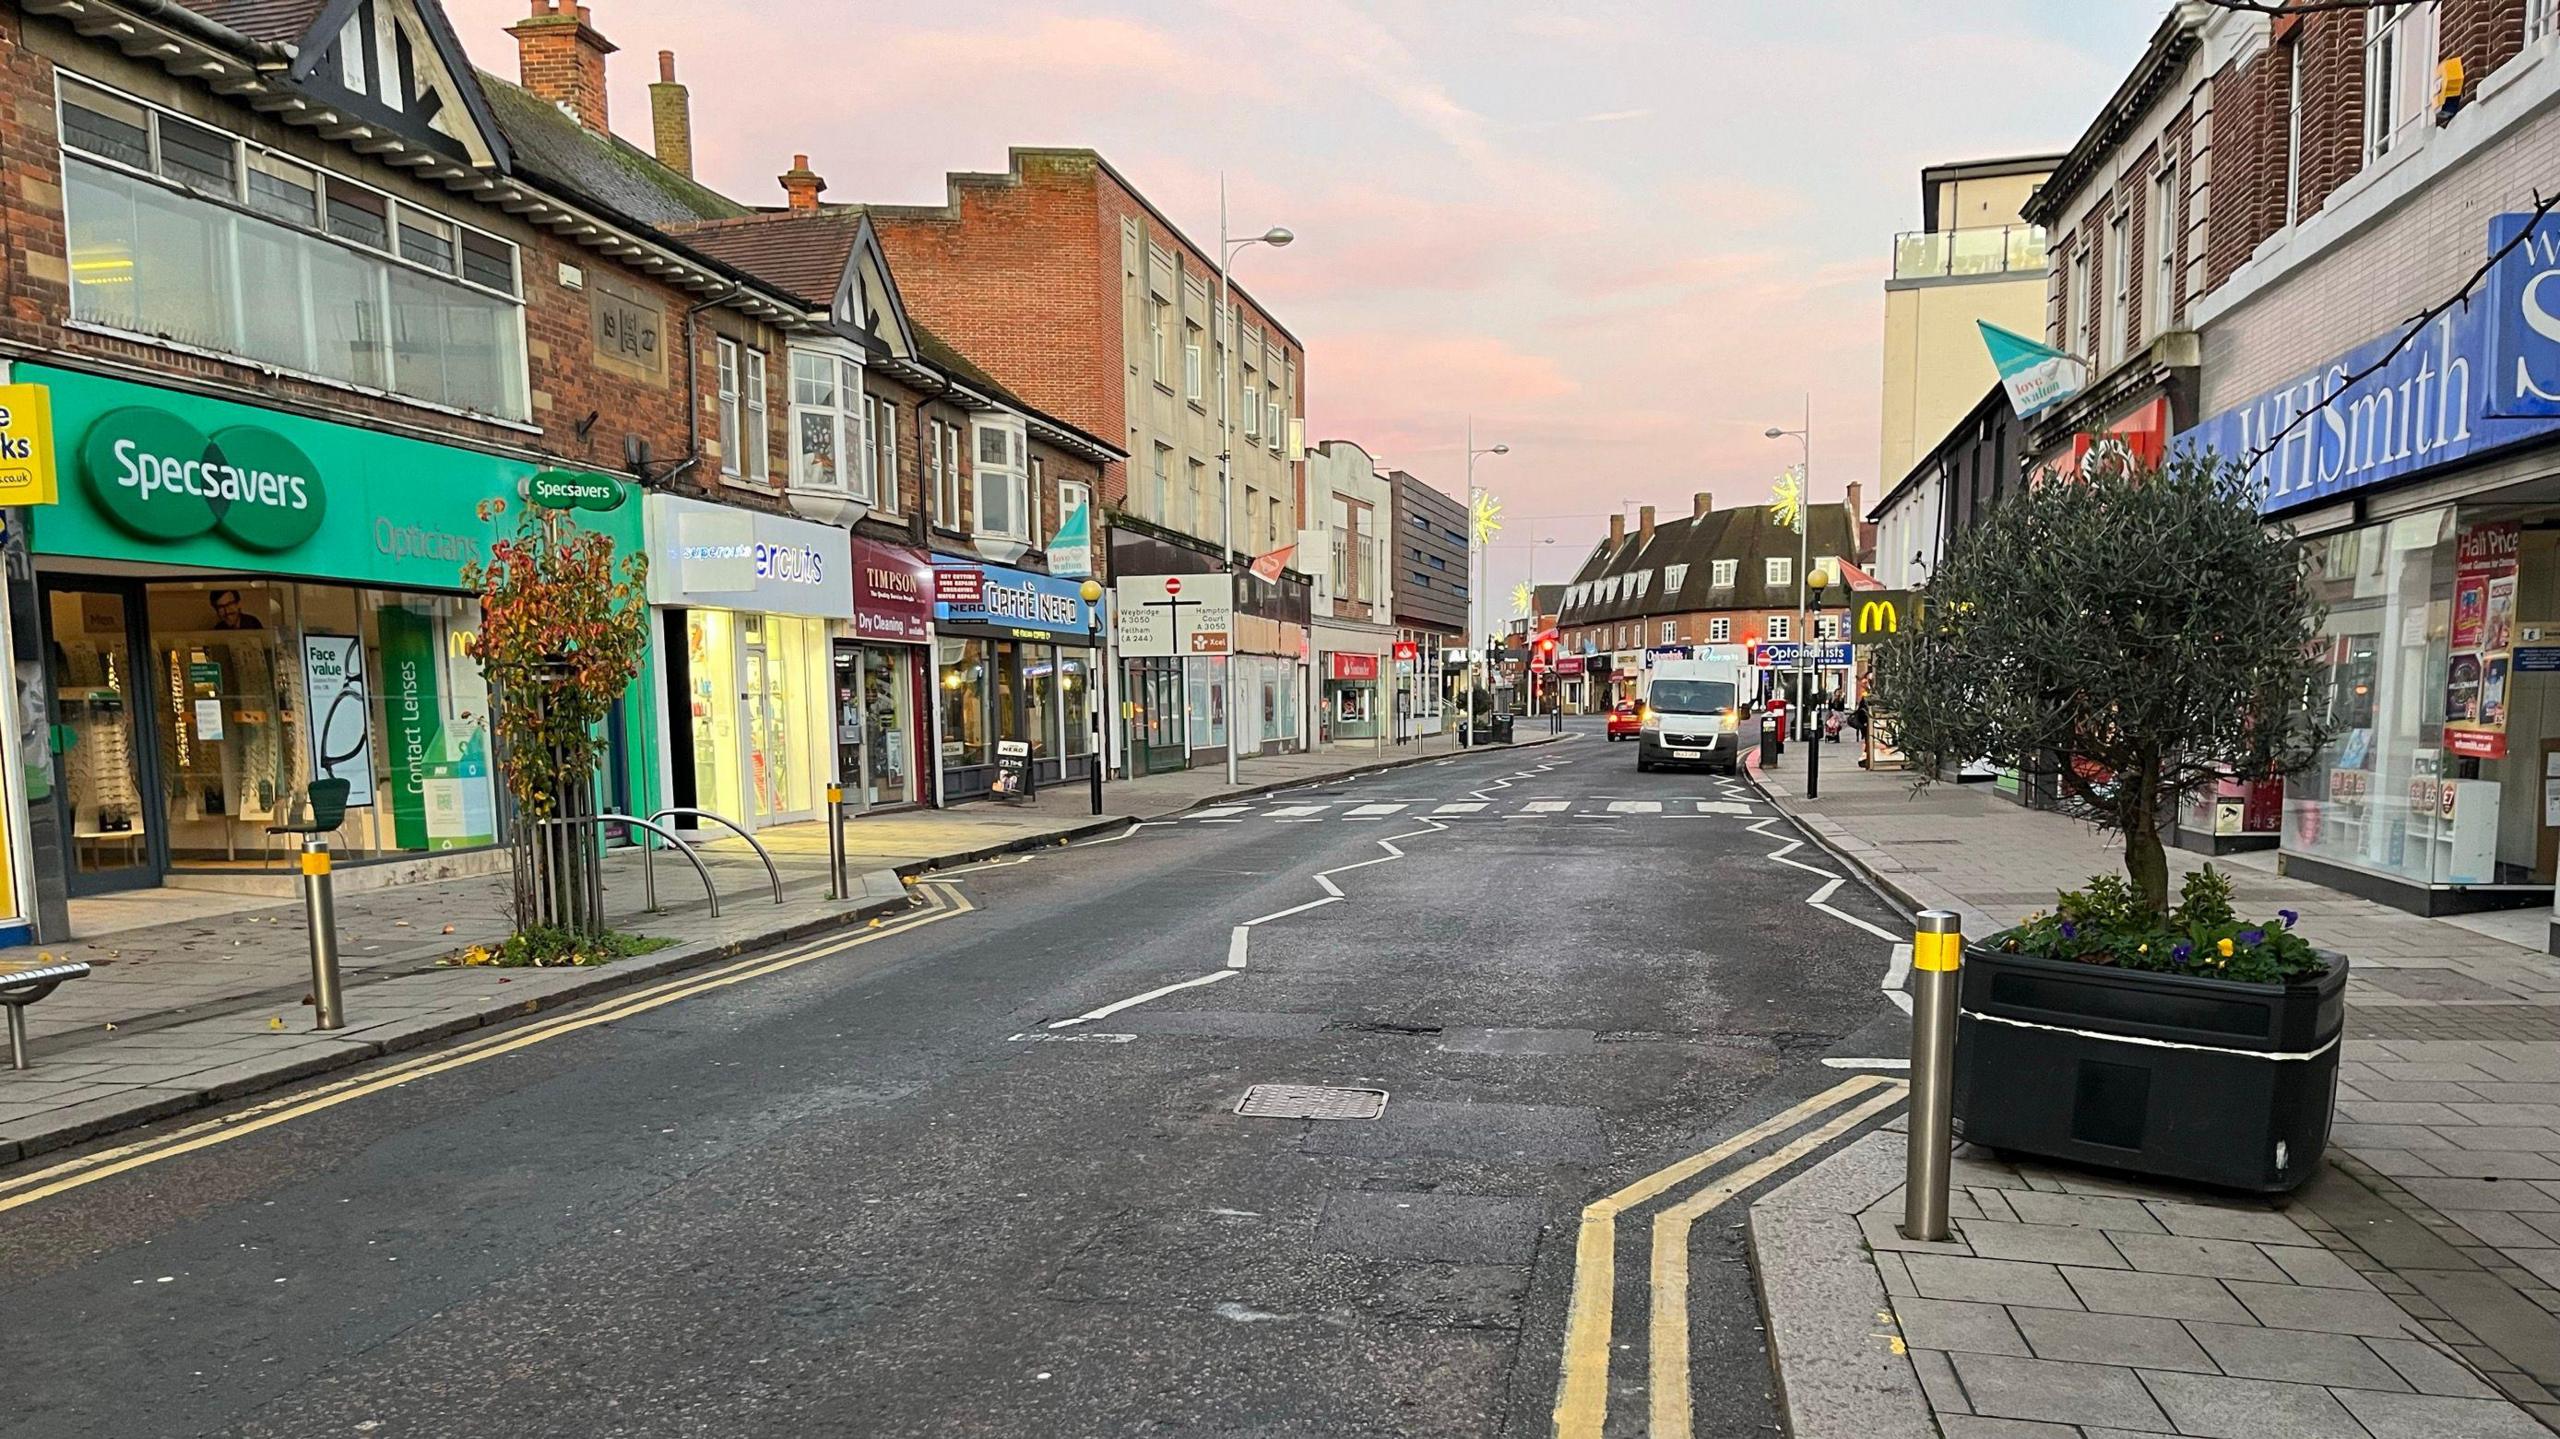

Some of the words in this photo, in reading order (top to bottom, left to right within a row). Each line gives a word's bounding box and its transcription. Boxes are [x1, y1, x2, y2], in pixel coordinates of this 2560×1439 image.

[2015, 377, 2043, 396] love
[2018, 381, 2060, 405] walton
[2240, 311, 2471, 499] WHSmith
[114, 439, 308, 509] Specsavers
[536, 480, 610, 498] Specsavers
[374, 517, 481, 561] Opticians
[2487, 528, 2519, 555] Price
[755, 541, 823, 585] ercuts
[1052, 553, 1071, 563] love
[866, 567, 917, 593] TIMPSON
[878, 591, 890, 599] Quality
[949, 604, 986, 612] NERO
[1040, 592, 1077, 625] NERO
[1120, 609, 1160, 617] Weybridge
[1196, 607, 1229, 615] Hampton
[859, 613, 872, 632] Dry
[873, 613, 904, 635] Cleaning
[1209, 638, 1226, 646] Xcel
[310, 647, 336, 661] Face
[1448, 649, 1483, 663] ALDI
[312, 662, 342, 676] value
[402, 660, 420, 721] Lenses
[405, 727, 424, 794] Contact
[2442, 790, 2455, 805] £7
